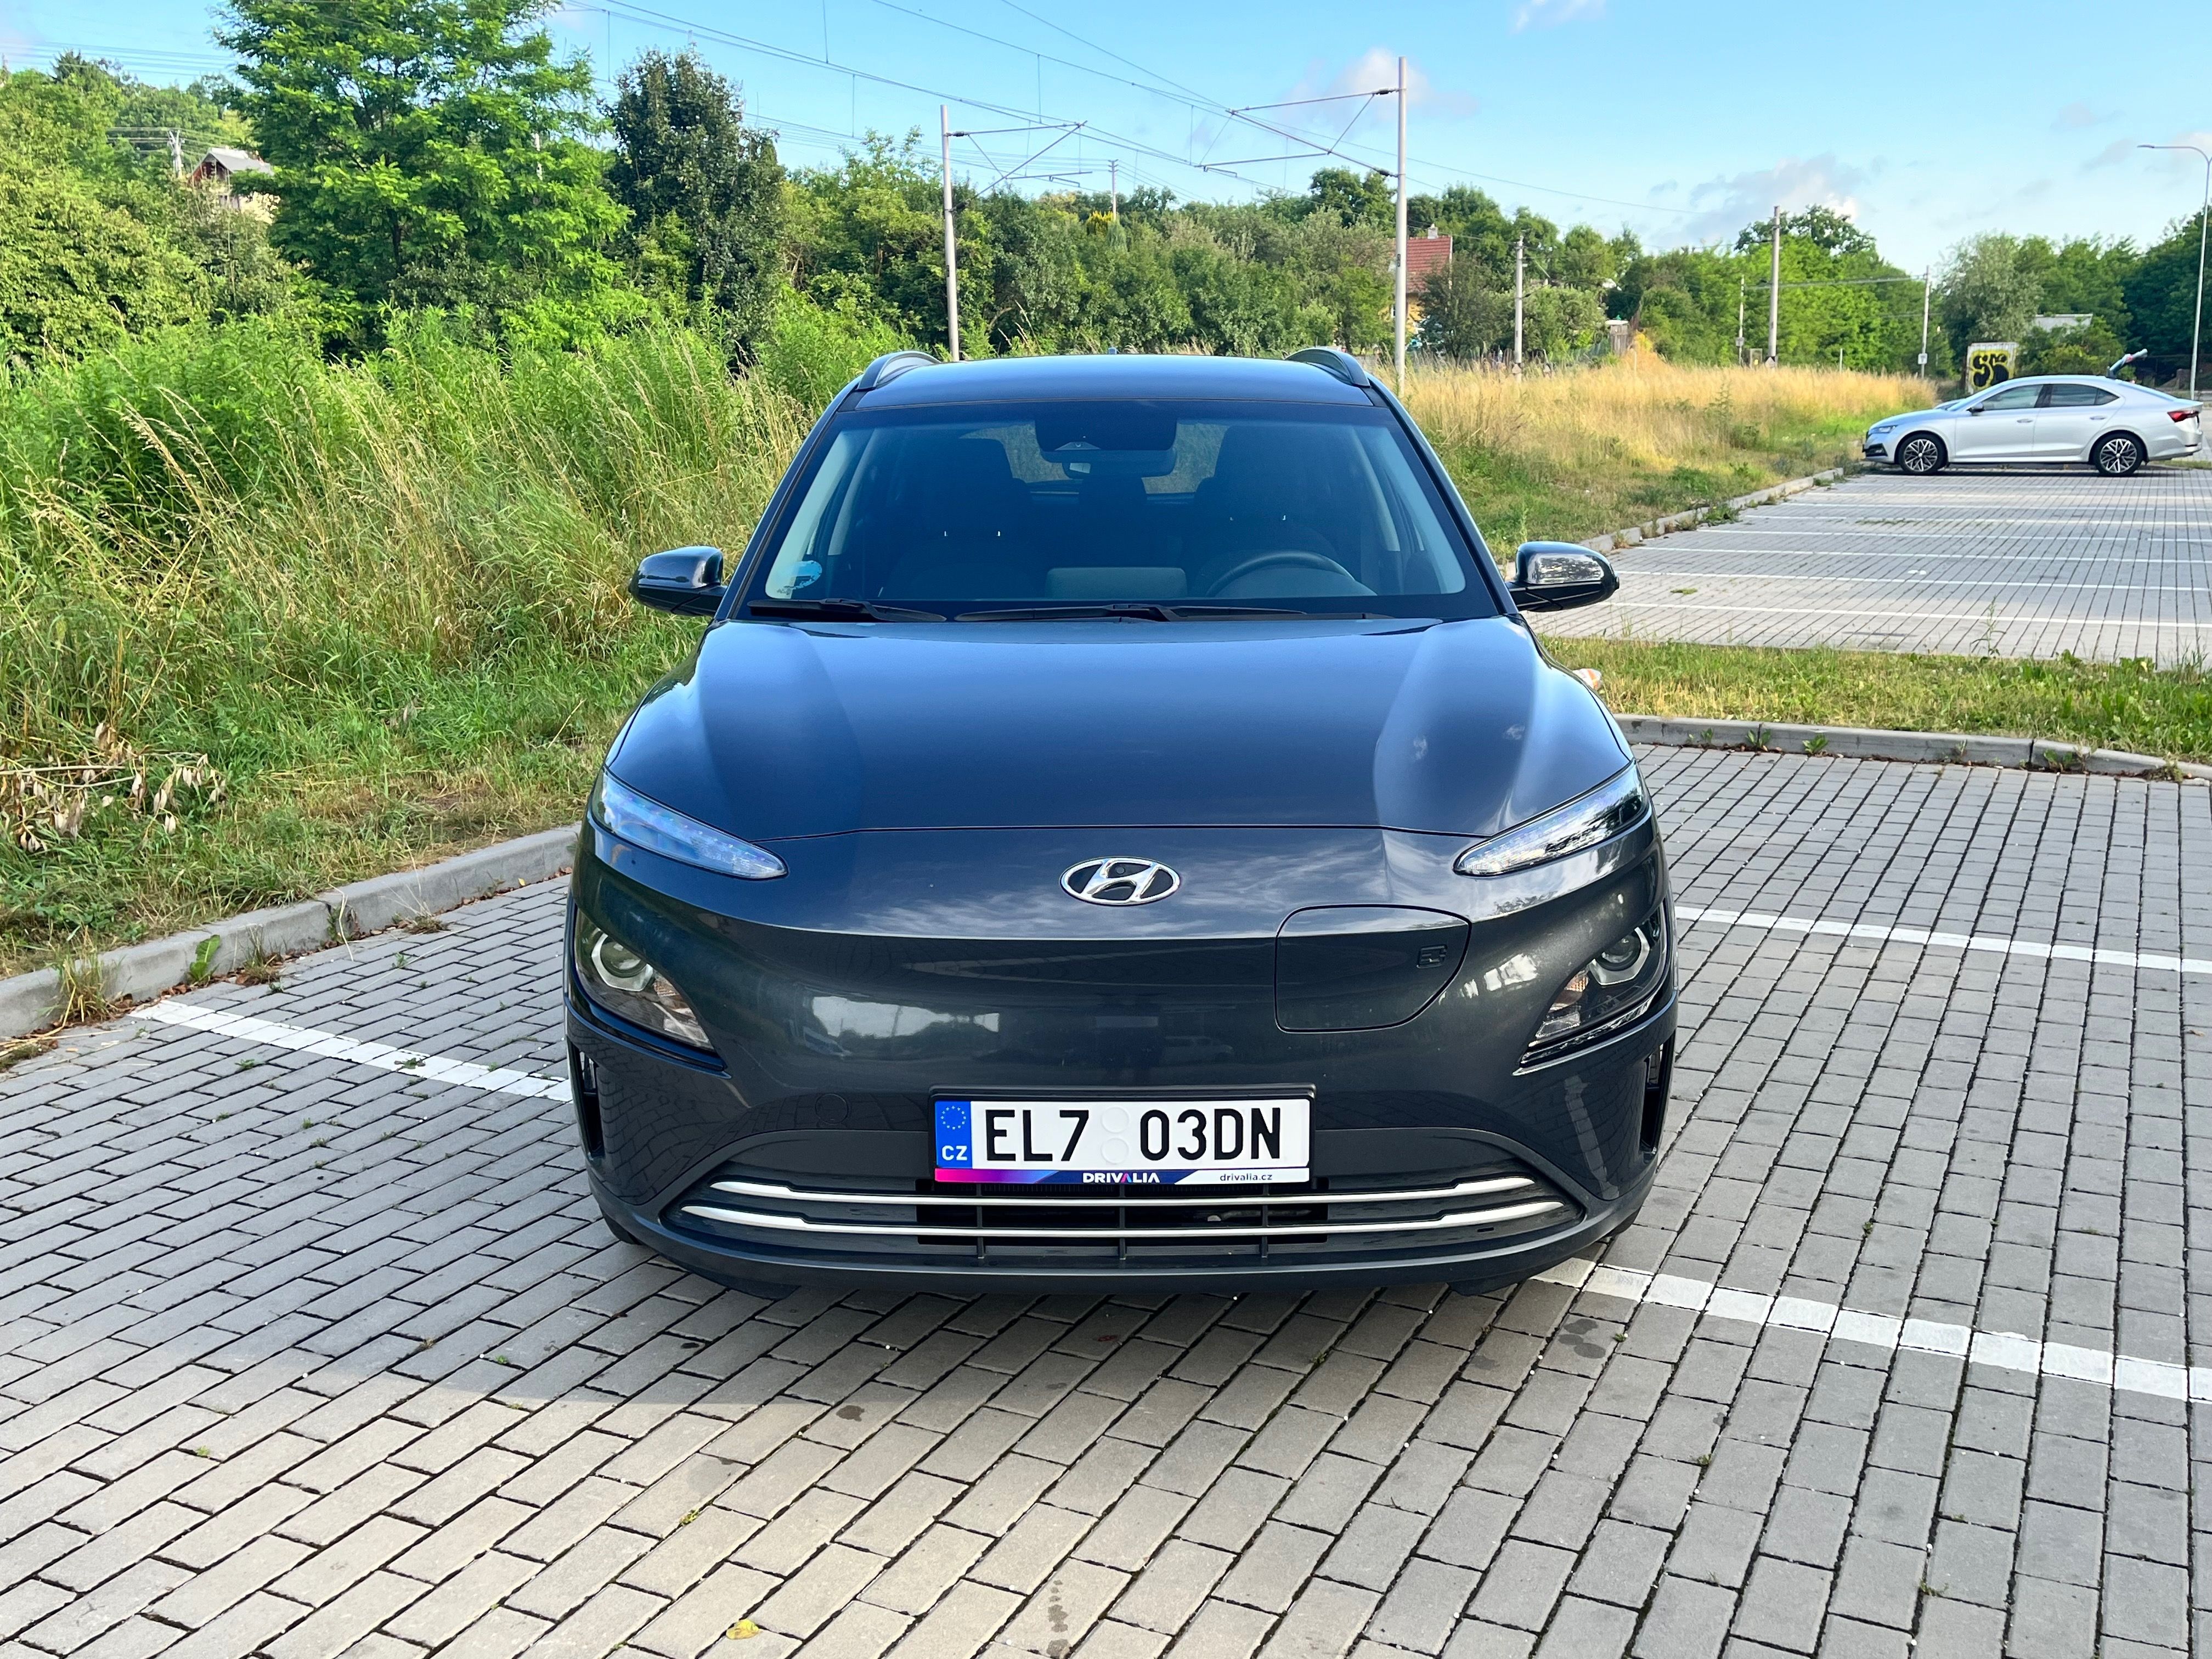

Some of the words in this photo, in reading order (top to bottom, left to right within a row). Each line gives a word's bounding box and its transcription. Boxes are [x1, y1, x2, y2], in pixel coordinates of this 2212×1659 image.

[985, 1109, 1089, 1161] EL7
[1140, 1107, 1280, 1161] 03DN
[941, 1145, 968, 1161] CZ
[1082, 1172, 1160, 1183] DRIVALIA
[1220, 1173, 1273, 1181] drivalia.cz
